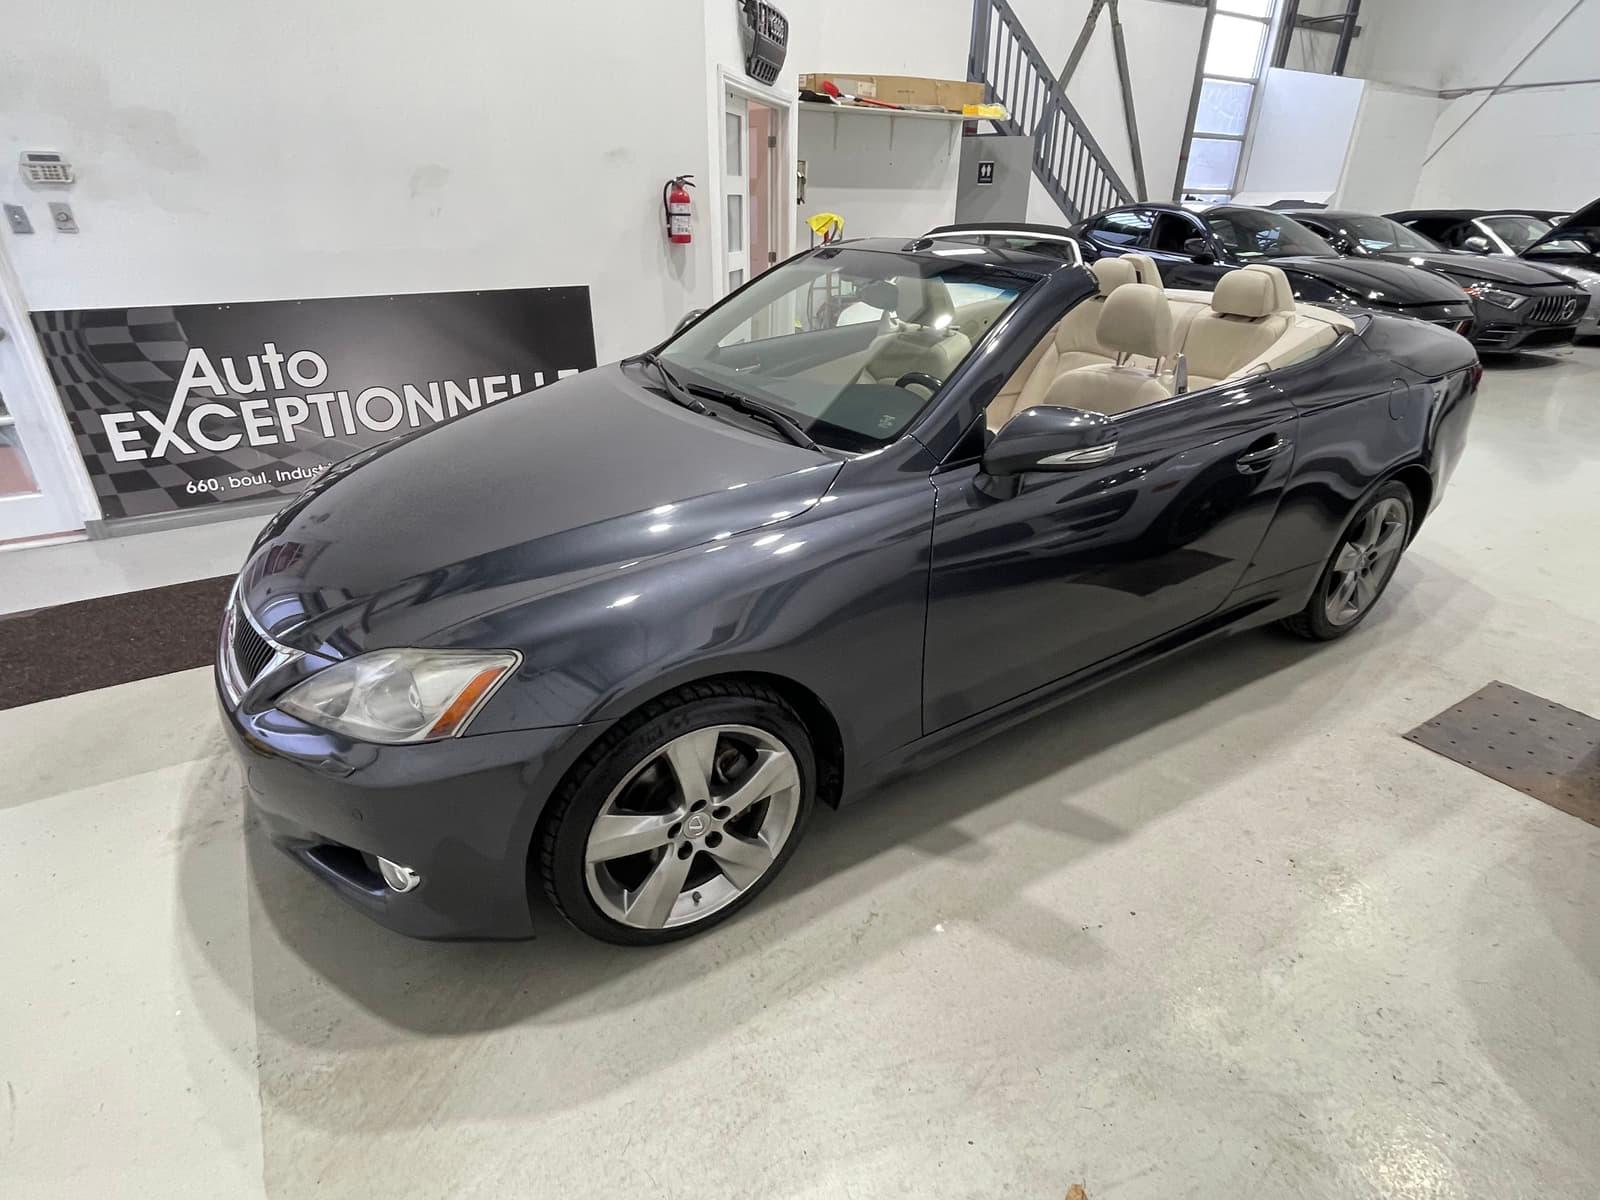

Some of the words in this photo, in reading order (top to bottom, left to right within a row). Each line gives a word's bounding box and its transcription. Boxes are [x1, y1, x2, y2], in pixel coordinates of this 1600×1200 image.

[174, 342, 328, 397] Auto
[100, 368, 579, 462] EXCEPTIONNE
[186, 478, 225, 494] 660,
[228, 471, 272, 489] boul.
